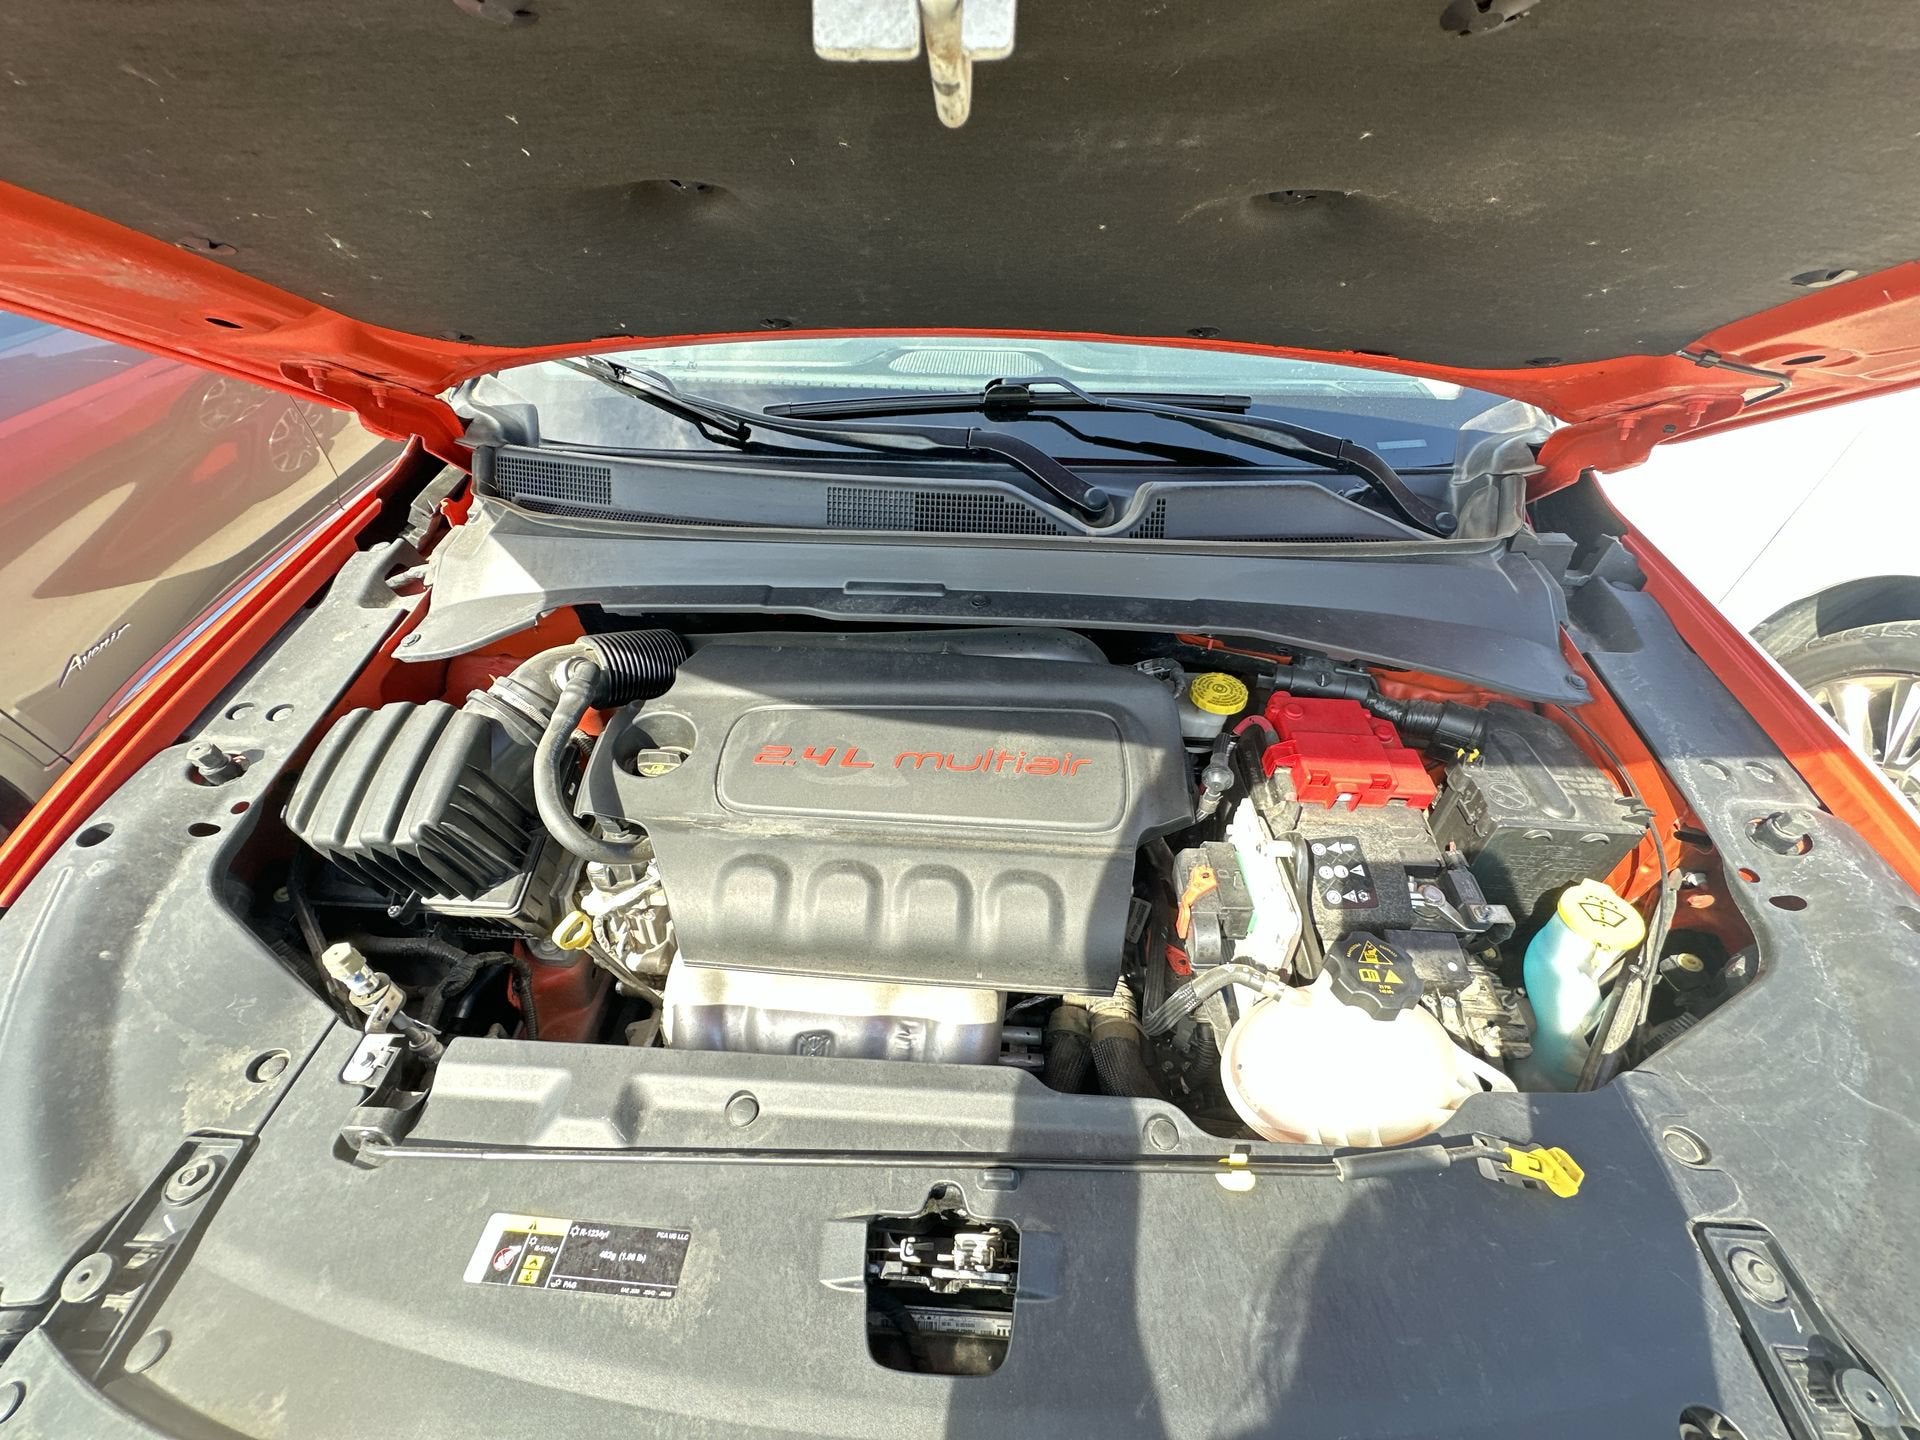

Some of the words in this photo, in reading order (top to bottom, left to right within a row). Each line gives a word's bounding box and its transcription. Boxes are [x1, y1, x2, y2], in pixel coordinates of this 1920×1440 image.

[58, 622, 130, 688] Avenir
[752, 744, 875, 769] 2.4L
[893, 747, 1094, 777] multiair
